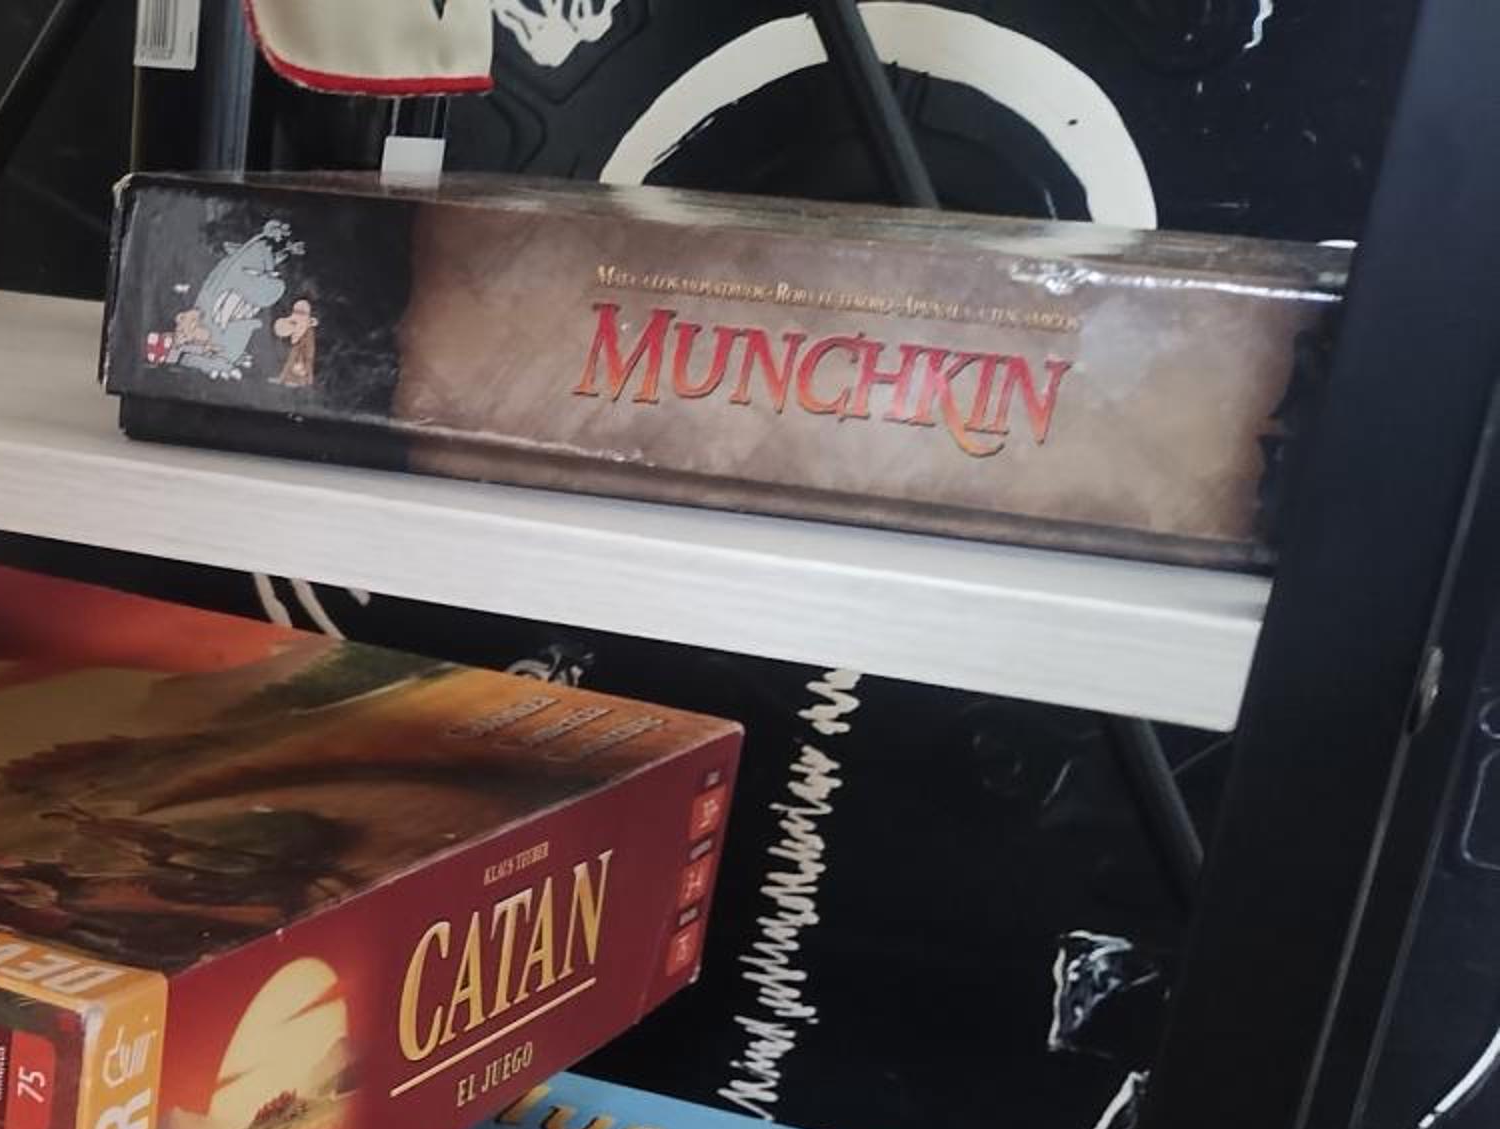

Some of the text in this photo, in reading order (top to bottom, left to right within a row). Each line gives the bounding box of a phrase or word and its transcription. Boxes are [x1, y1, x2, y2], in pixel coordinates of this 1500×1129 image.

[572, 303, 1072, 458] MUNCHKIN
[399, 848, 614, 1062] CATAN
[16, 1066, 46, 1104] 75
[456, 1041, 534, 1108] EL JUEGO
